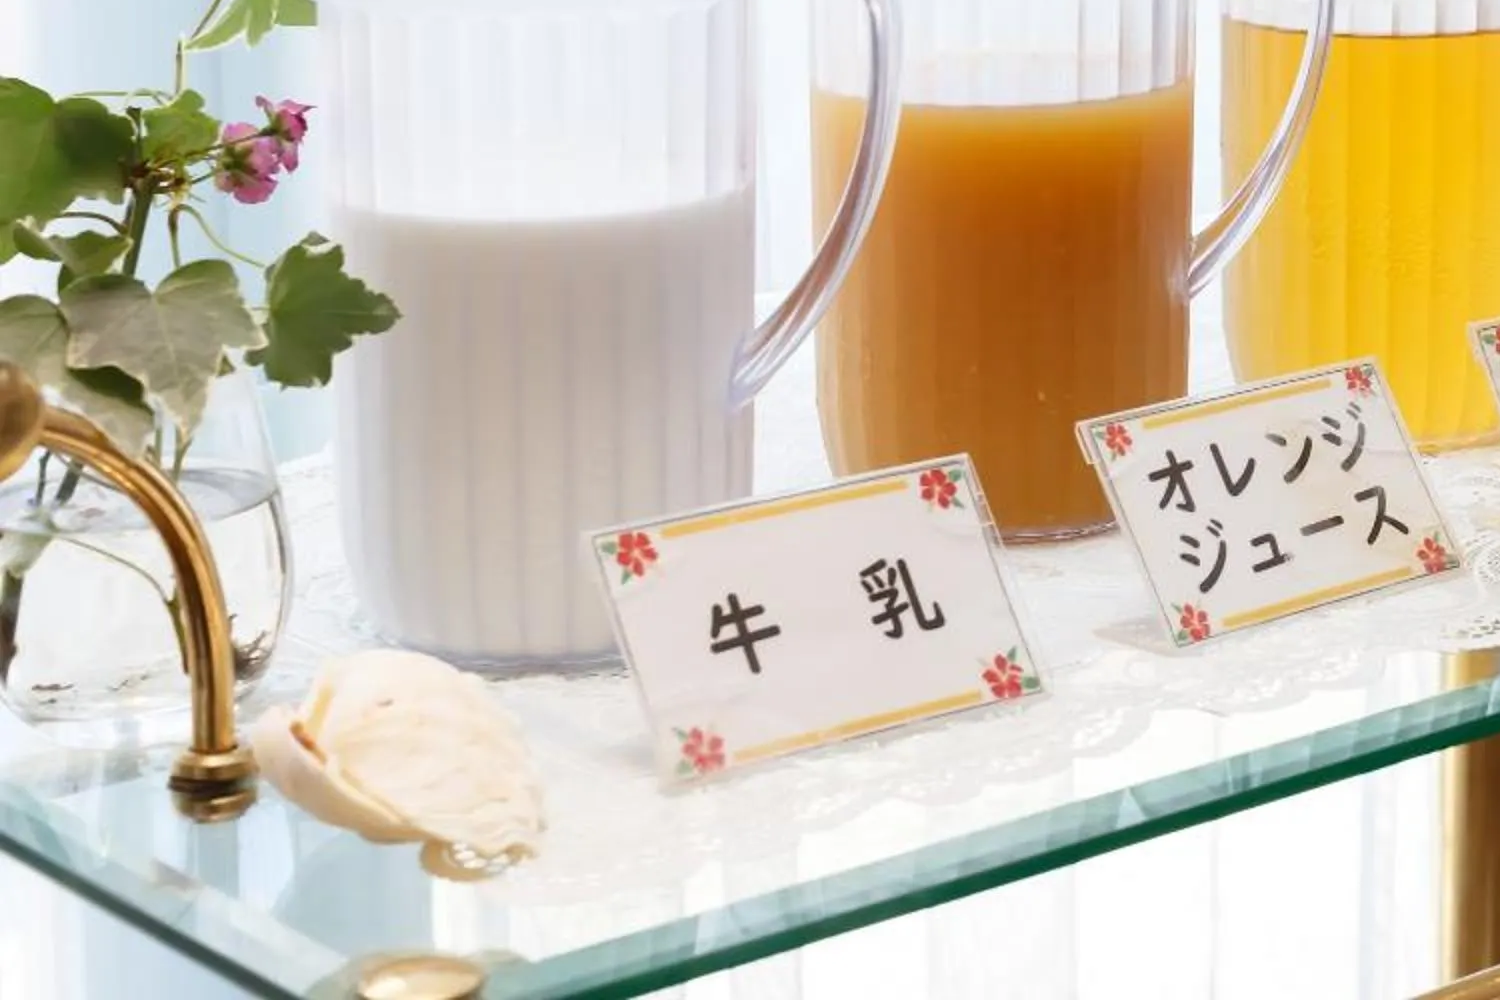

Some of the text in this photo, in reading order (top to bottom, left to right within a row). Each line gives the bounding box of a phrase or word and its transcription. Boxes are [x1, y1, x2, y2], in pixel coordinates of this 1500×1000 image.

[1148, 401, 1366, 513] オレンジ
[1179, 485, 1410, 594] ジュース
